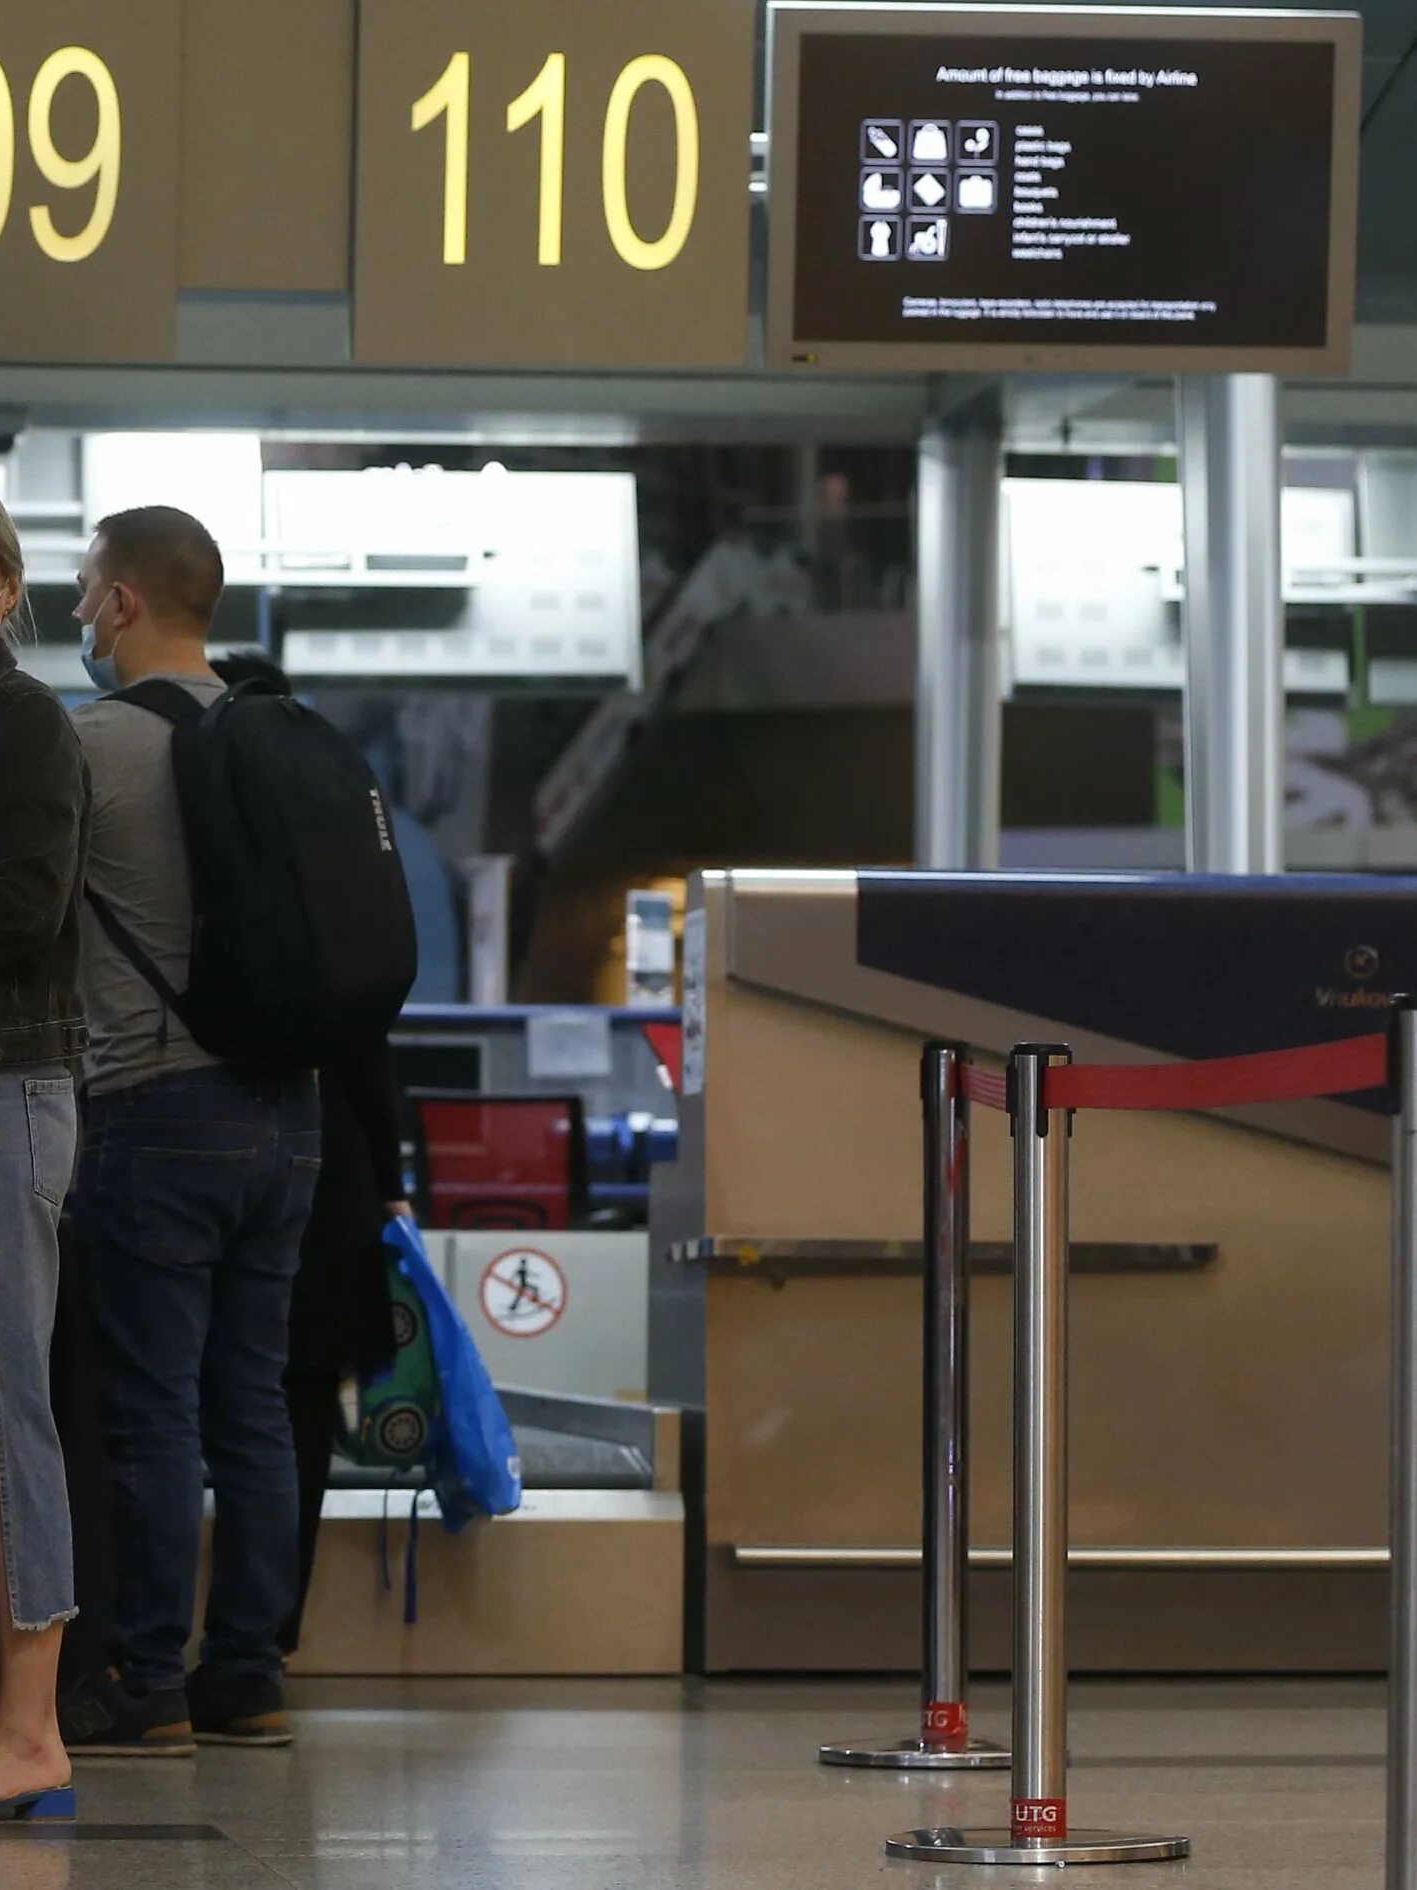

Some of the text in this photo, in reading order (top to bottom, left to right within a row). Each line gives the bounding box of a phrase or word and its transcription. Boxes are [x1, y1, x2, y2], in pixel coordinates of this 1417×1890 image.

[936, 65, 987, 83] Amount
[988, 66, 1004, 84] of
[1005, 67, 1031, 84] free
[1032, 67, 1090, 87] baggage
[1091, 68, 1104, 85] is
[1105, 68, 1137, 85] fixed
[1138, 69, 1155, 88] by
[411, 52, 699, 270] 110
[1016, 1804, 1057, 1822] UTG
